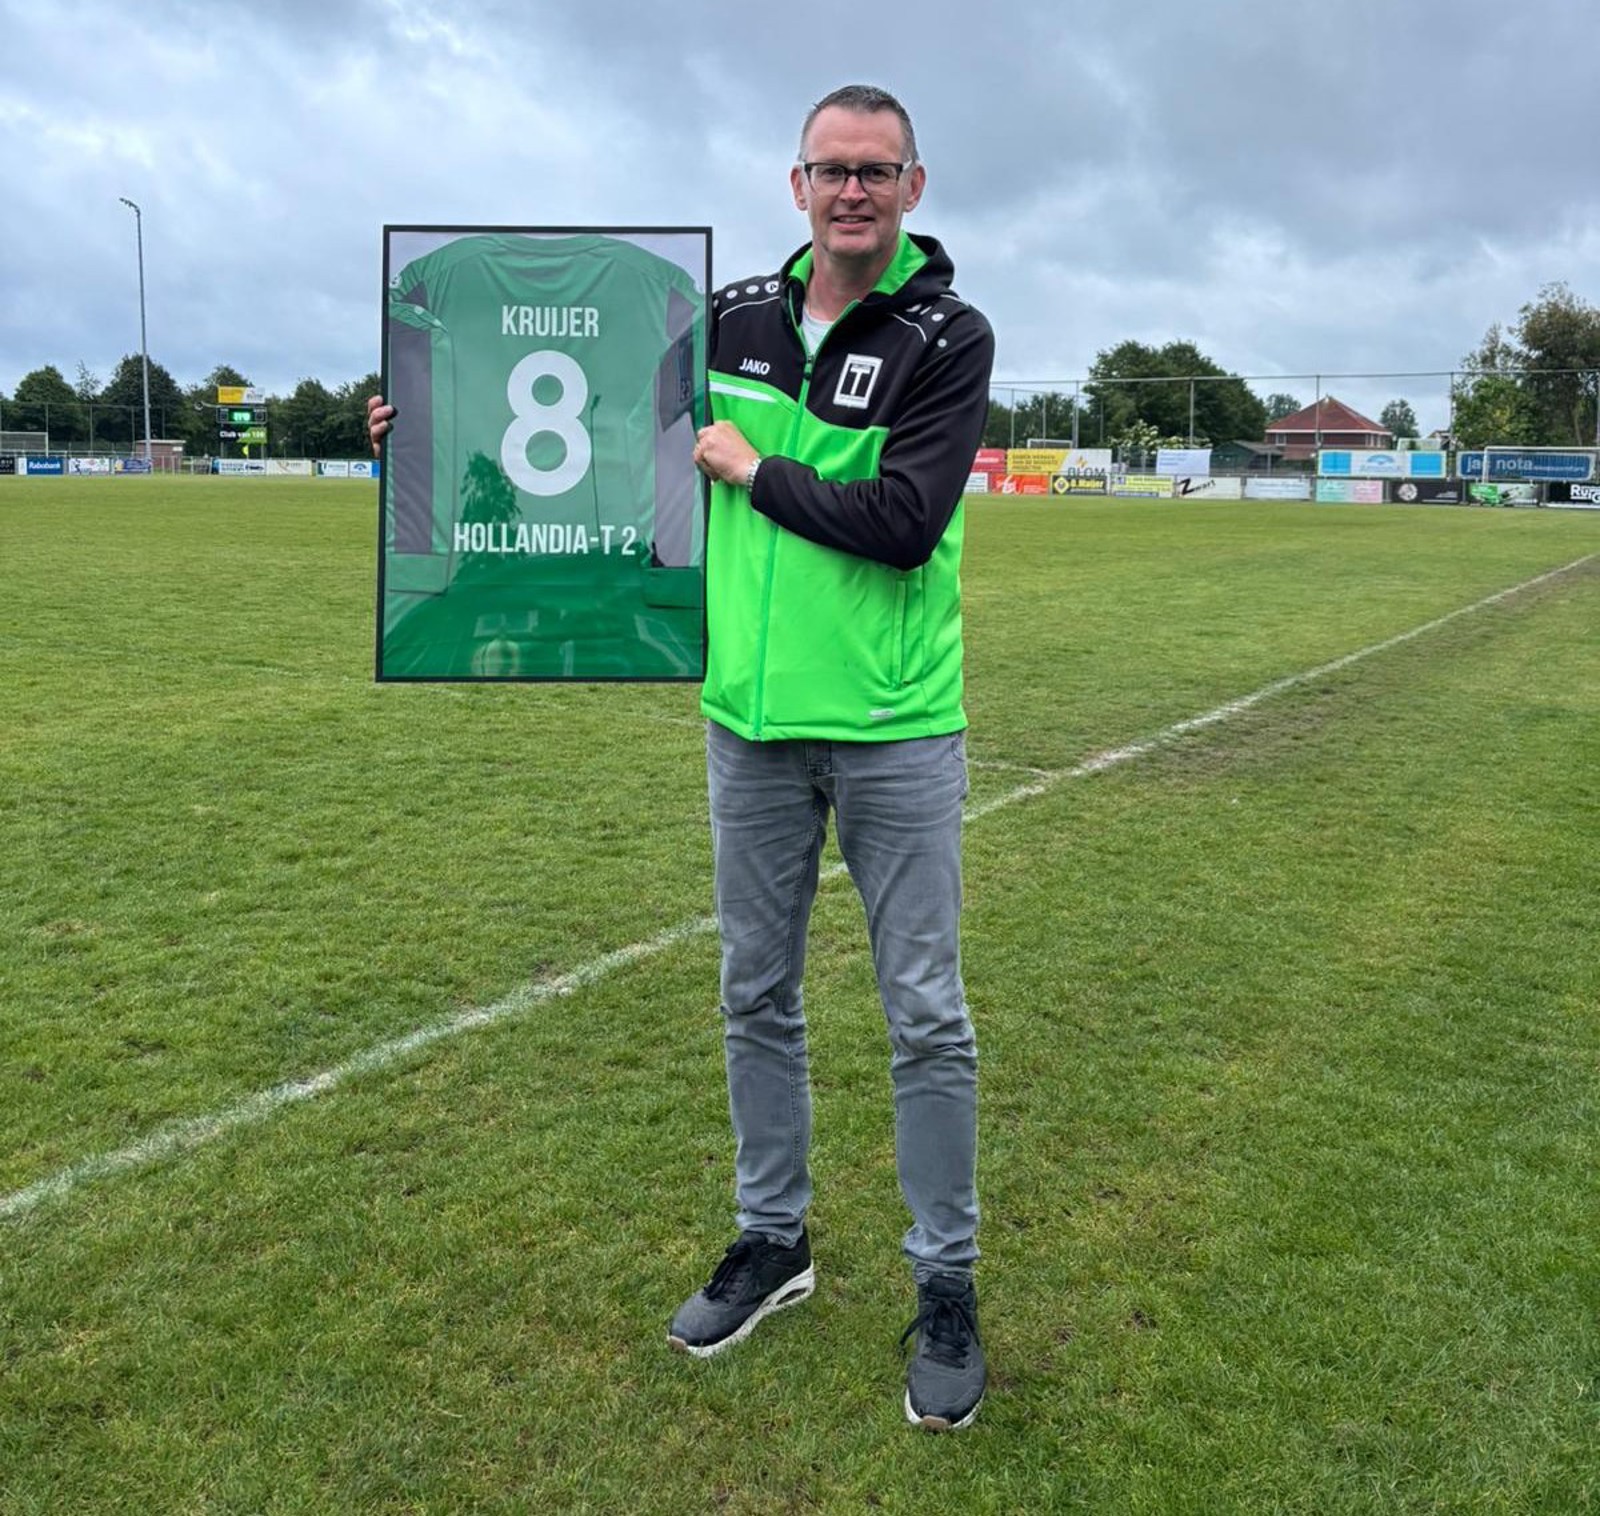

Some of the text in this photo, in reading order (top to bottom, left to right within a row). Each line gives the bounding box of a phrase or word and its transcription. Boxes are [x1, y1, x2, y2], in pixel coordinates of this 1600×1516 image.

[502, 305, 599, 337] KRUIJER
[739, 357, 770, 376] JAKO
[500, 350, 592, 497] 8
[28, 461, 61, 470] Rabobank
[1496, 457, 1533, 471] nota
[453, 522, 637, 556] HOLLANDIA-T 2
